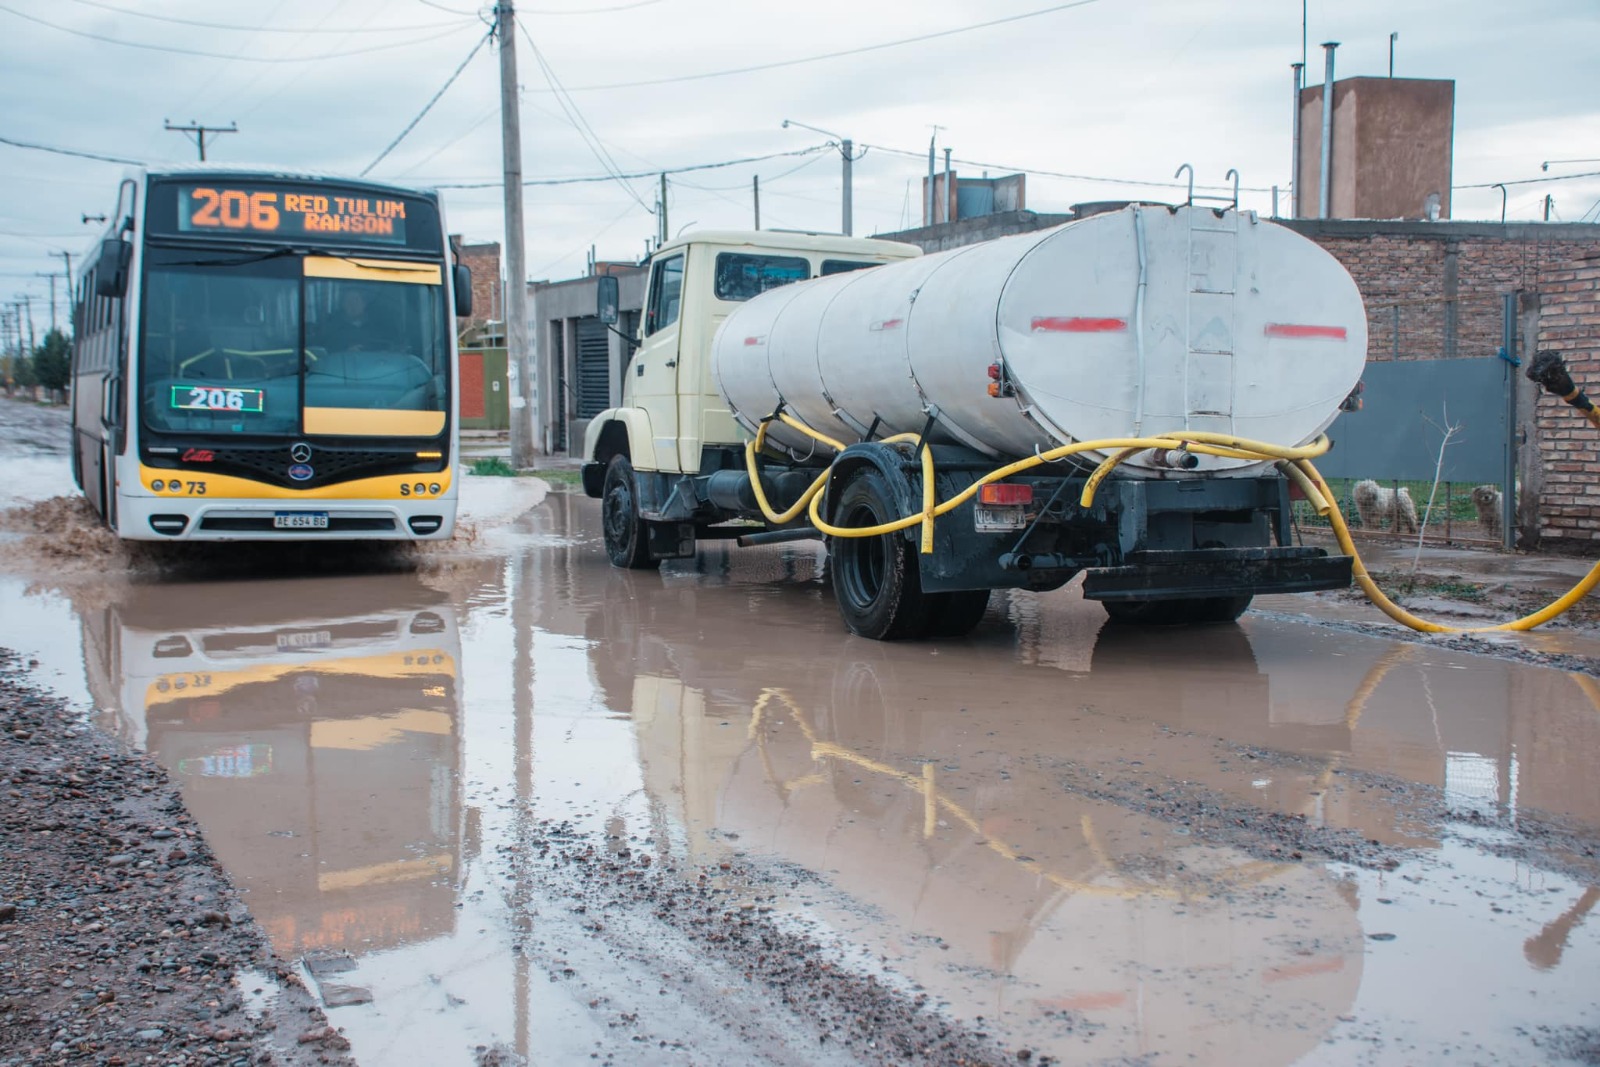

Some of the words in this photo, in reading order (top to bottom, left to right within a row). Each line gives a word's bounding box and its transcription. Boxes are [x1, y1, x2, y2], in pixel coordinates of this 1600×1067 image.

[191, 188, 280, 231] 206
[284, 194, 329, 214] RED
[334, 197, 406, 219] TULUM
[304, 213, 393, 234] RAWSON
[189, 389, 245, 411] 206
[186, 481, 207, 495] 73
[400, 483, 411, 496] S
[277, 516, 289, 526] AE
[292, 516, 310, 526] 654
[313, 516, 326, 526] BG
